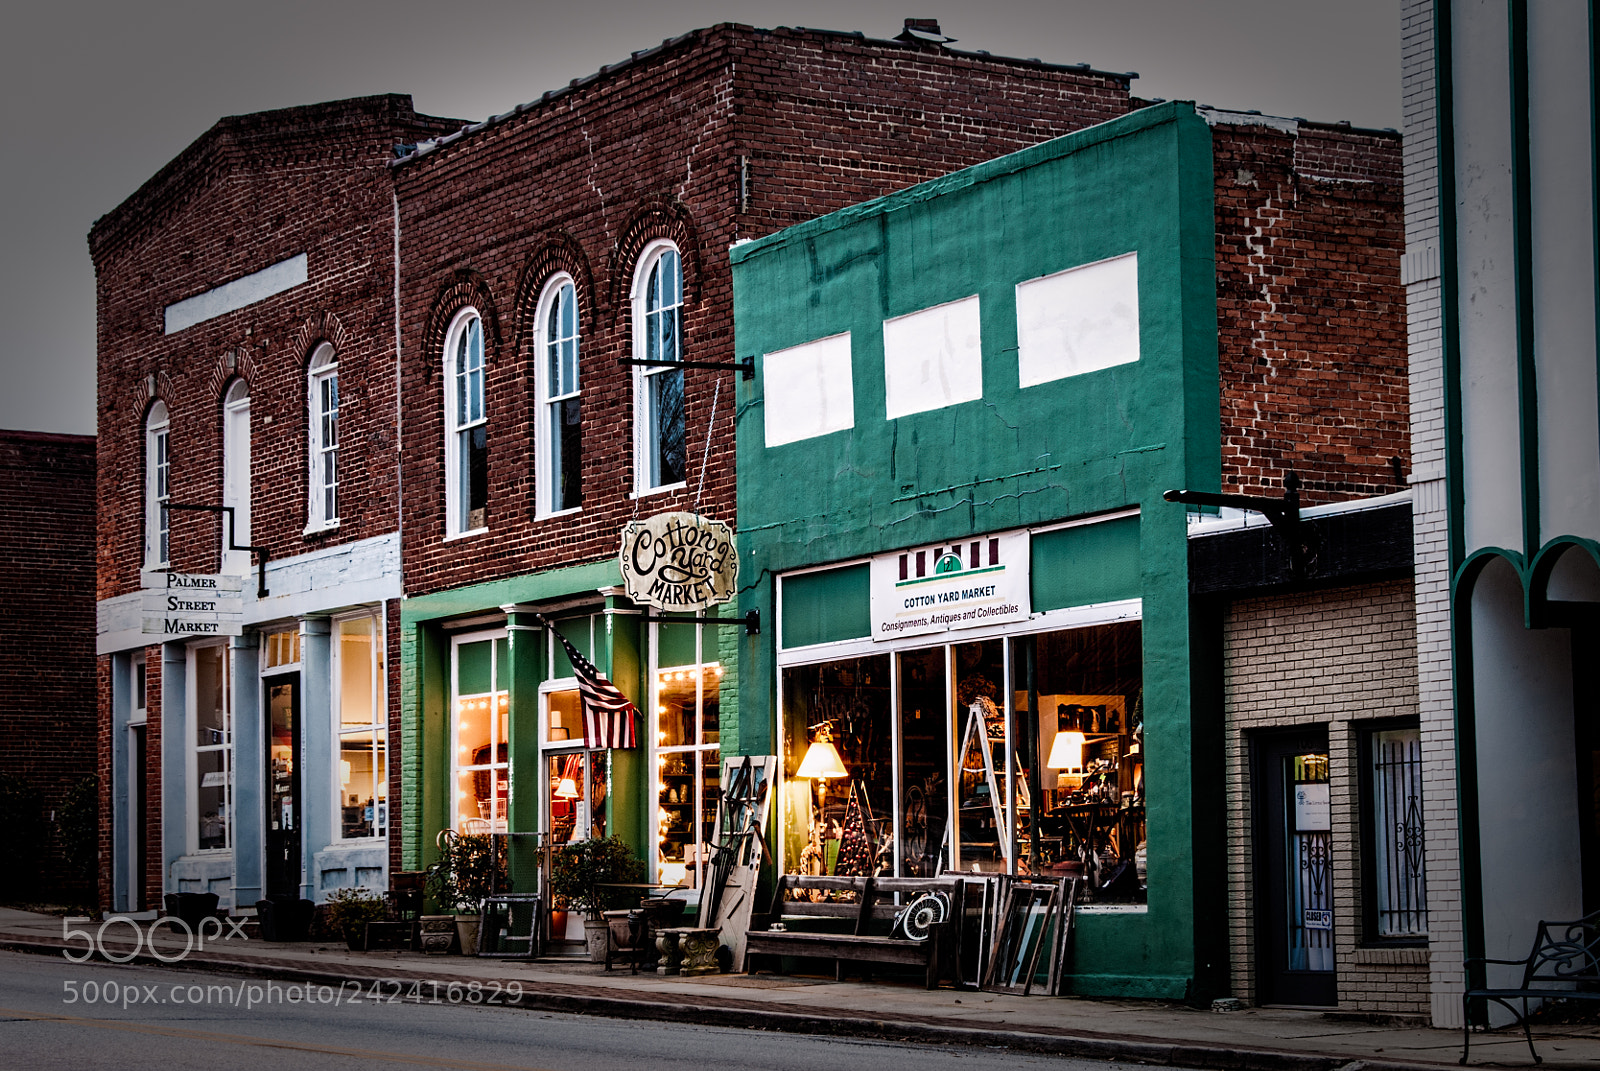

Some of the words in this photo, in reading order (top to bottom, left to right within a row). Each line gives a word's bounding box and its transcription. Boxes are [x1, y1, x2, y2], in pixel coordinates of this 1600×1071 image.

[632, 519, 717, 576] Cotton
[658, 541, 729, 583] Yard
[166, 573, 217, 589] PALMER
[647, 576, 718, 605] MARKET
[167, 596, 216, 611] STREET
[904, 594, 935, 609] COTTON
[937, 591, 960, 604] YARD
[961, 585, 996, 600] MARKET
[164, 618, 219, 634] MARKET
[881, 617, 929, 632] Consignments,
[930, 613, 961, 625] Antiques
[963, 609, 977, 620] and
[977, 603, 1019, 618] Collectibles
